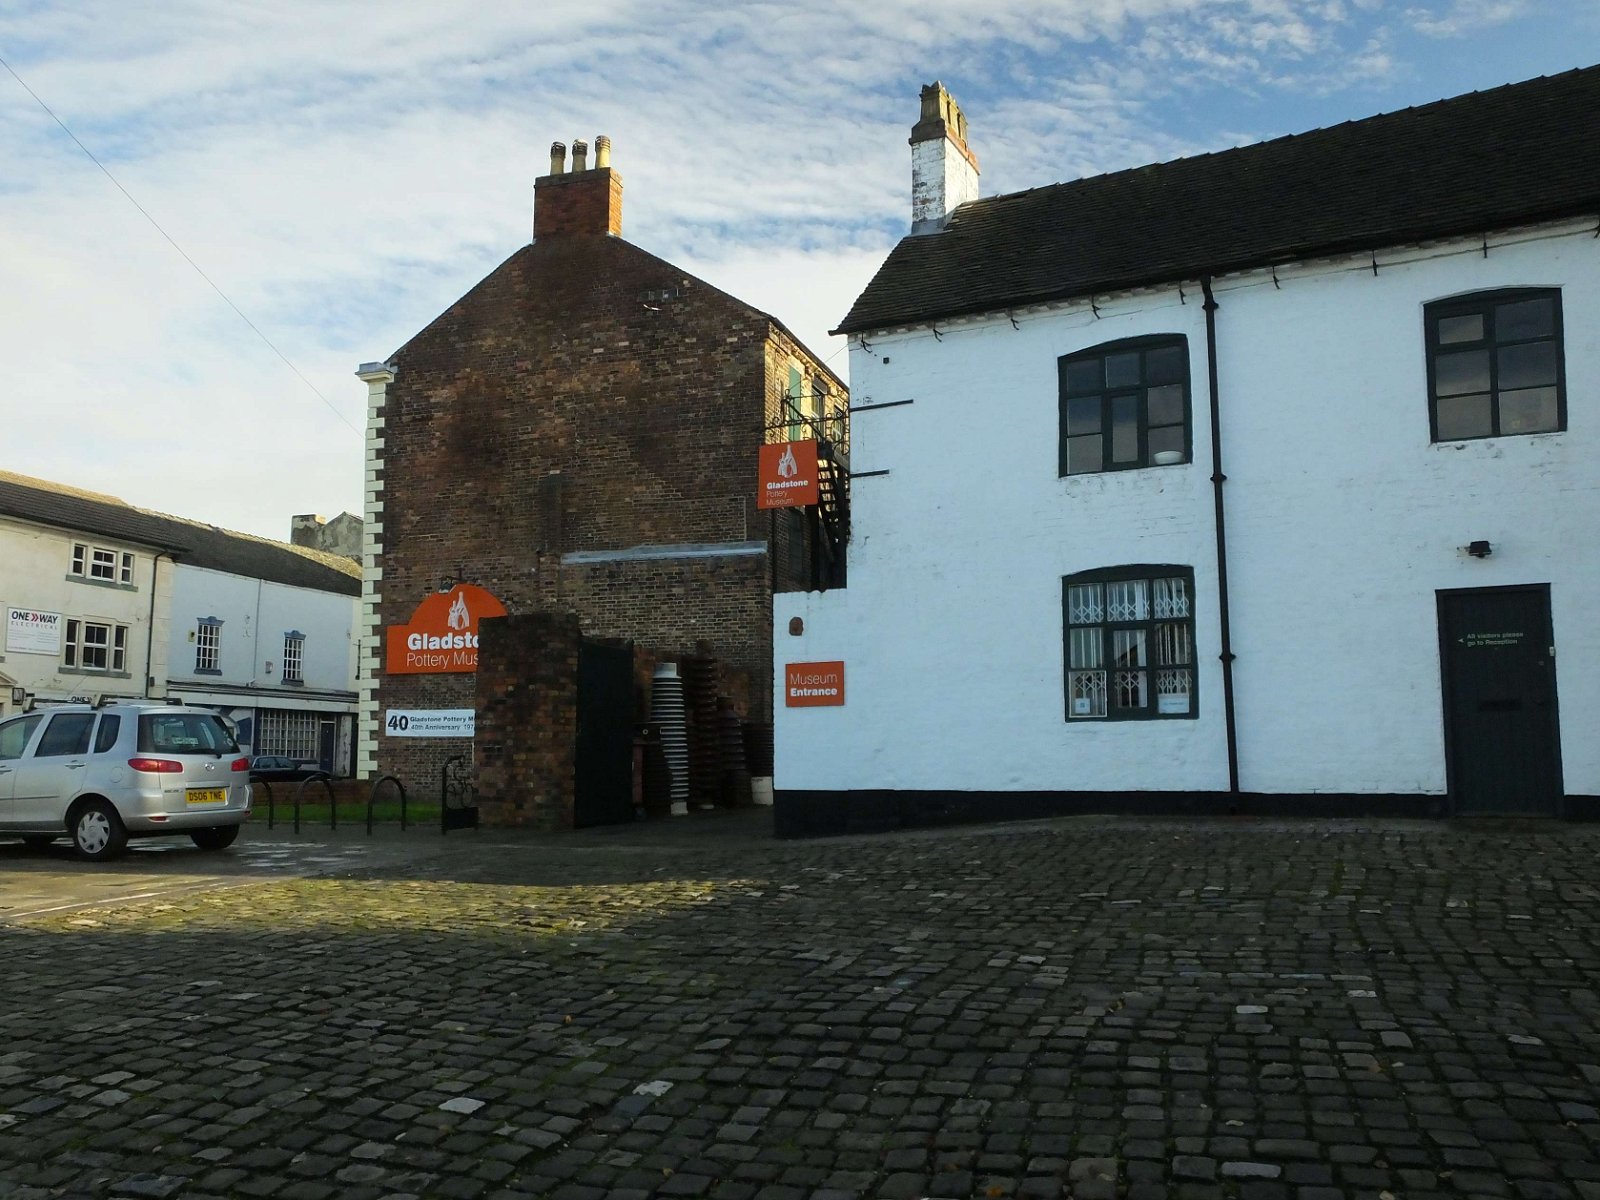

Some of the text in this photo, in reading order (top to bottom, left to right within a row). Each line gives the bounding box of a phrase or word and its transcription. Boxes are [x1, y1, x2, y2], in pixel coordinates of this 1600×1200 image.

[767, 480, 808, 489] Gladstone
[766, 490, 787, 498] Pottery
[11, 611, 58, 624] ONE WAY
[407, 652, 450, 669] Pottery
[790, 672, 838, 685] Museum
[790, 687, 838, 697] Entrance
[388, 715, 409, 731] 40
[188, 791, 223, 801] DS06 TNE
